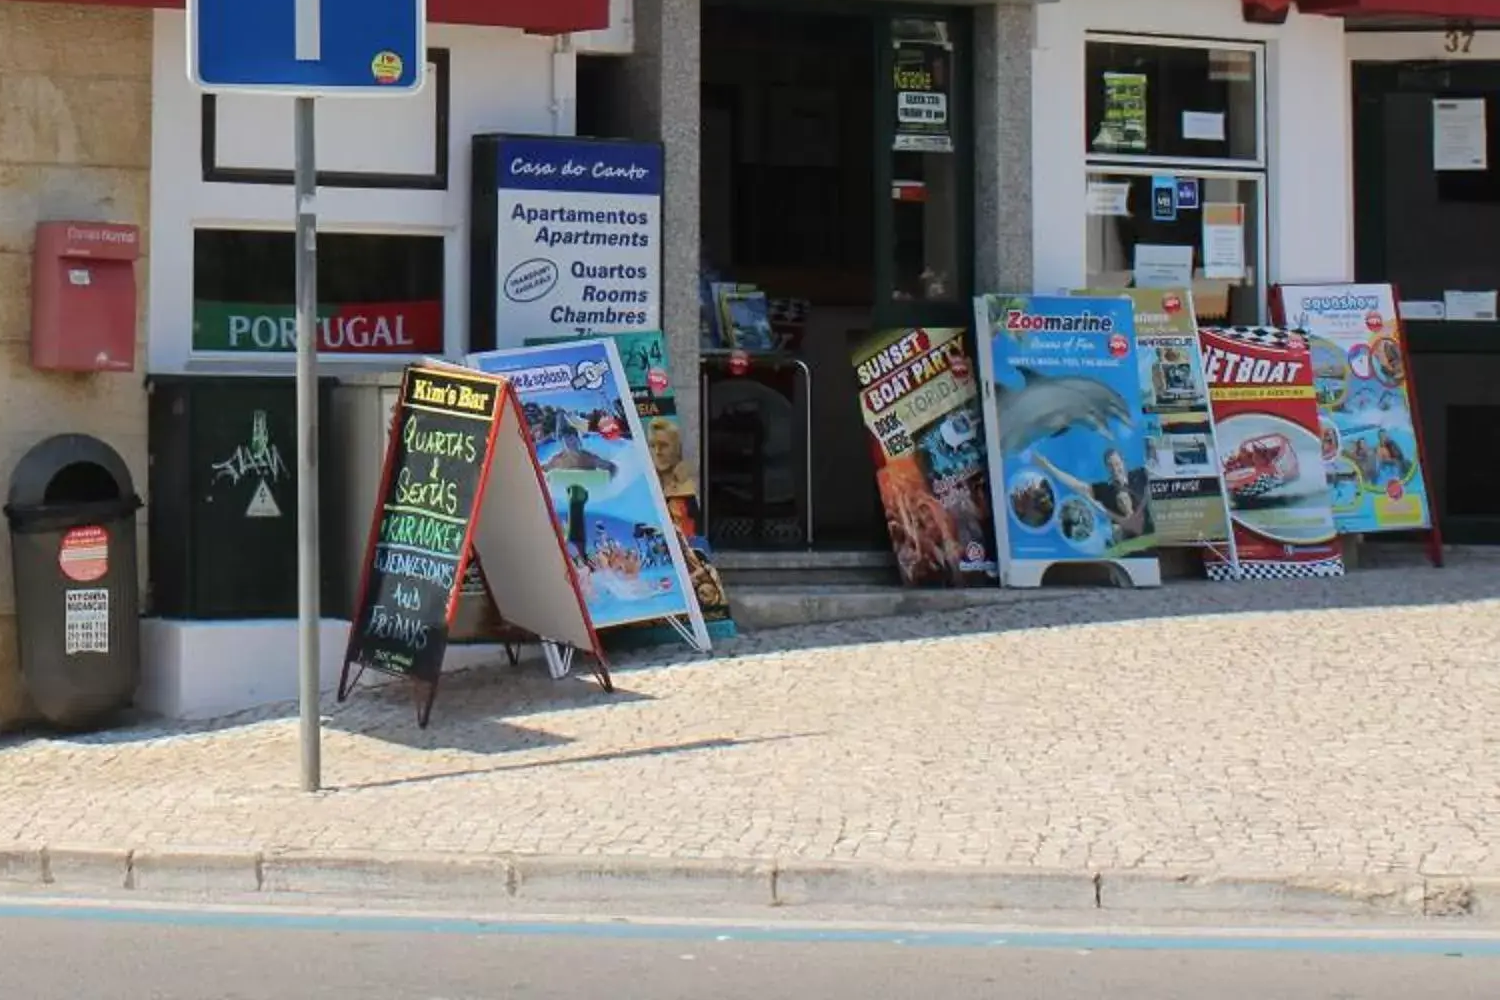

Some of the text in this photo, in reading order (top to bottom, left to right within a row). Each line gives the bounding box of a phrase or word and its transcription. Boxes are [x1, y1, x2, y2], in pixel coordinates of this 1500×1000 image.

[1444, 29, 1475, 54] 37
[510, 157, 649, 180] Casa do Canto
[511, 203, 648, 225] Apartamentos
[535, 226, 649, 248] Apartments
[571, 261, 648, 279] Quartos
[582, 285, 648, 303] Rooms
[550, 305, 647, 324] Chambres
[1007, 311, 1112, 332] Zoomarine
[857, 329, 921, 386] SUNSET
[868, 335, 963, 412] BOAT PARTY
[413, 379, 489, 411] Kim's Bar
[403, 416, 476, 464] QUARTAS
[396, 467, 457, 513] SEXTAS
[374, 548, 454, 588] WEDNESDAYS
[393, 583, 421, 611] AND
[367, 604, 429, 648] FRIDAYS
